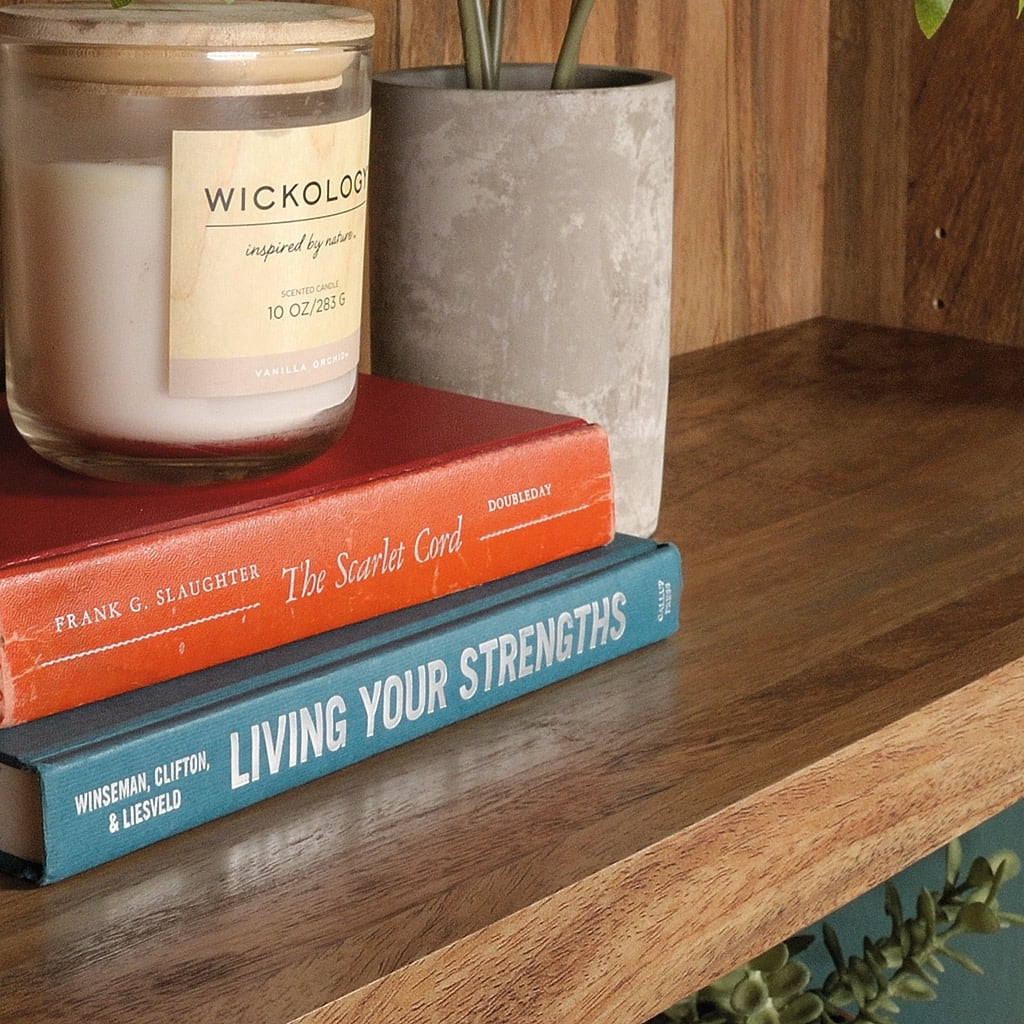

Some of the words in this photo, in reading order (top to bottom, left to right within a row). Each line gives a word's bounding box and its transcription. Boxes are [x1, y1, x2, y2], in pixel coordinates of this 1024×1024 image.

[245, 233, 307, 263] inspired
[306, 233, 324, 260] by
[267, 305, 284, 320] 10
[289, 295, 337, 317] OZ/283
[338, 292, 346, 306] G
[281, 286, 315, 298] SCENTED
[255, 363, 307, 377] VANILLA
[487, 483, 552, 512] DOUBLEDAY
[281, 559, 327, 604] The
[334, 536, 406, 589] Scarlet
[414, 514, 464, 564] Cord
[54, 601, 122, 633] FRANK
[129, 596, 149, 613] G.
[156, 564, 261, 606] SLAUGHTER
[229, 694, 347, 790] LIVING
[358, 658, 449, 739] YOUR
[458, 591, 627, 701] STRENGTHS
[74, 771, 151, 816] WINSEMAN,
[154, 750, 211, 787] CLIFTON,
[108, 812, 120, 834] &
[122, 788, 183, 829] LIESVELD
